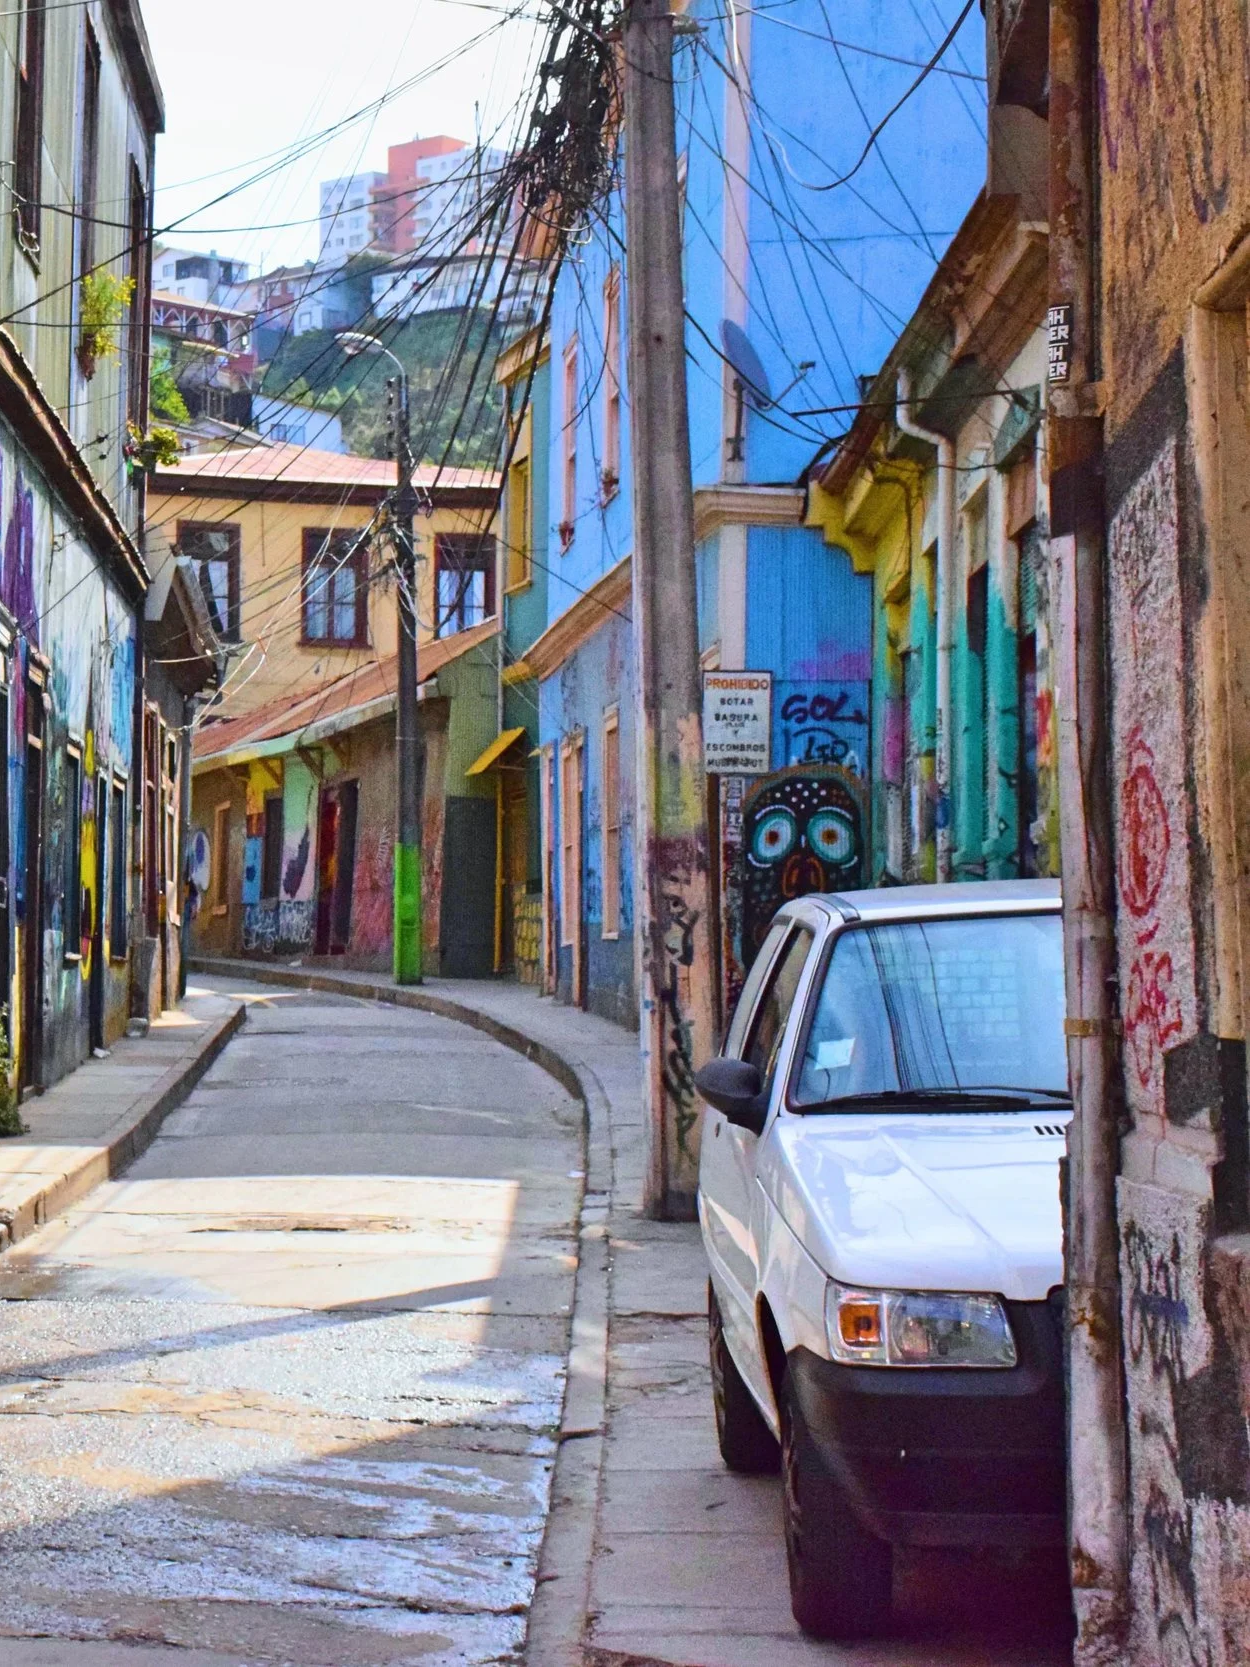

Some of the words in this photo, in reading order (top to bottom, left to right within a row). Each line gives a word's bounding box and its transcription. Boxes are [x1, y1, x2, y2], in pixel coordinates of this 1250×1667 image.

[706, 679, 768, 690] PROHIBIDO
[720, 698, 754, 706] BOTAR
[714, 713, 759, 722] BASURA
[706, 743, 766, 752] ESCOMBROS
